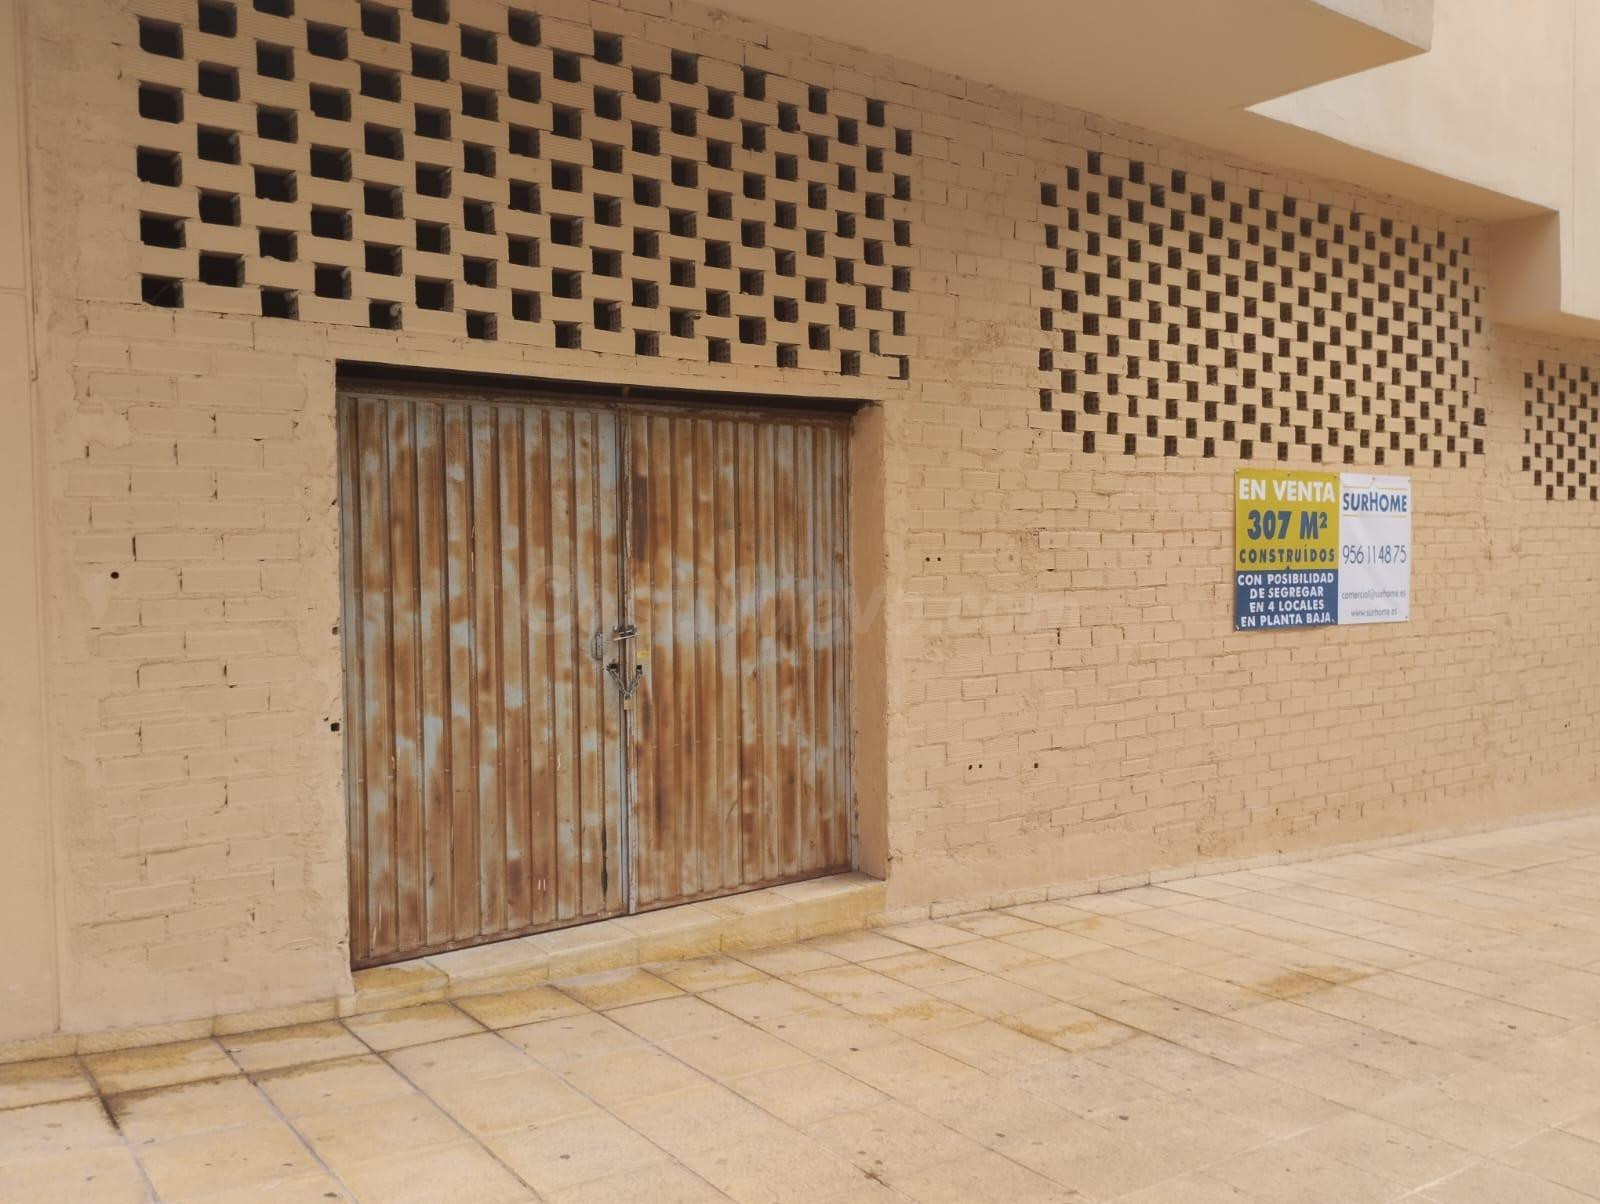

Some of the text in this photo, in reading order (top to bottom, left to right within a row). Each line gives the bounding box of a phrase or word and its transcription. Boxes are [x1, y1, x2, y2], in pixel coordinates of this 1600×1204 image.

[1238, 478, 1336, 503] EN VENTA
[1342, 491, 1408, 513] SURHOME
[1247, 509, 1292, 540] 307
[1239, 544, 1335, 564] CONSTRUÍDOS
[1237, 572, 1334, 586] CON POSIBILIDAD
[1250, 586, 1324, 599] DE SEGREGAR
[1249, 599, 1325, 613] EN 4 LOCALES
[1240, 616, 1256, 627] EN
[1260, 614, 1302, 626] PLANTA
